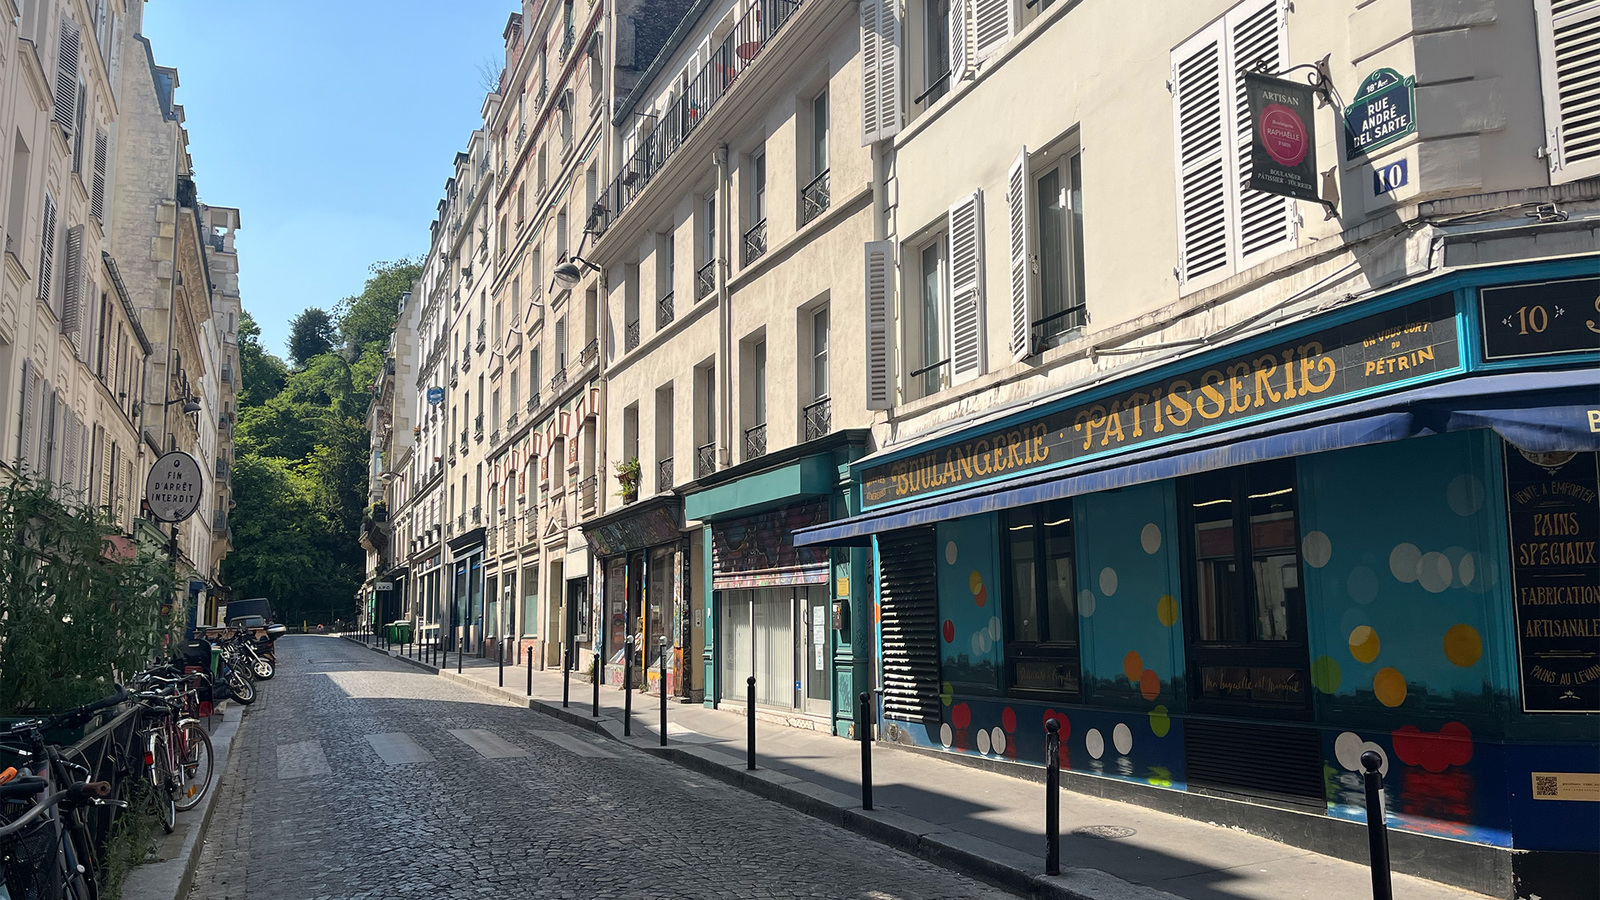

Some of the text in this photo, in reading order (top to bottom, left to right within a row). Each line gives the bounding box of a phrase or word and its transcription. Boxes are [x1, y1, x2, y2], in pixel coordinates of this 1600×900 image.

[1262, 90, 1299, 106] ARTISAN
[1368, 96, 1389, 116] RUE
[1362, 104, 1397, 132] ANDRÉ
[1266, 127, 1300, 142] RAPHAËLLE
[1353, 114, 1407, 148] DEL SARTE
[1257, 172, 1285, 184] PÂTISSIER
[1270, 168, 1302, 181] BOULANGER
[1378, 164, 1402, 193] 10
[1516, 305, 1548, 335] 10
[1363, 322, 1431, 348] ON VOUS SORT
[1391, 340, 1401, 349] DU
[1365, 345, 1435, 377] PÉTRIN
[891, 422, 1049, 495] BOULANGERIE
[1074, 341, 1336, 450] PATISSERIE
[167, 471, 183, 480] FIN
[155, 481, 193, 492] D'ARRÊT
[1513, 485, 1541, 505] VENTE
[1551, 481, 1596, 504] EMPORTER
[151, 493, 194, 503] INTERDIT
[1533, 511, 1580, 537] PAINS
[1519, 541, 1597, 566] SPECIAUX
[1521, 585, 1600, 606] FABRICATION
[1526, 618, 1600, 638] ARTISANALE
[1530, 664, 1600, 686] PAINS AU LEVAIN
